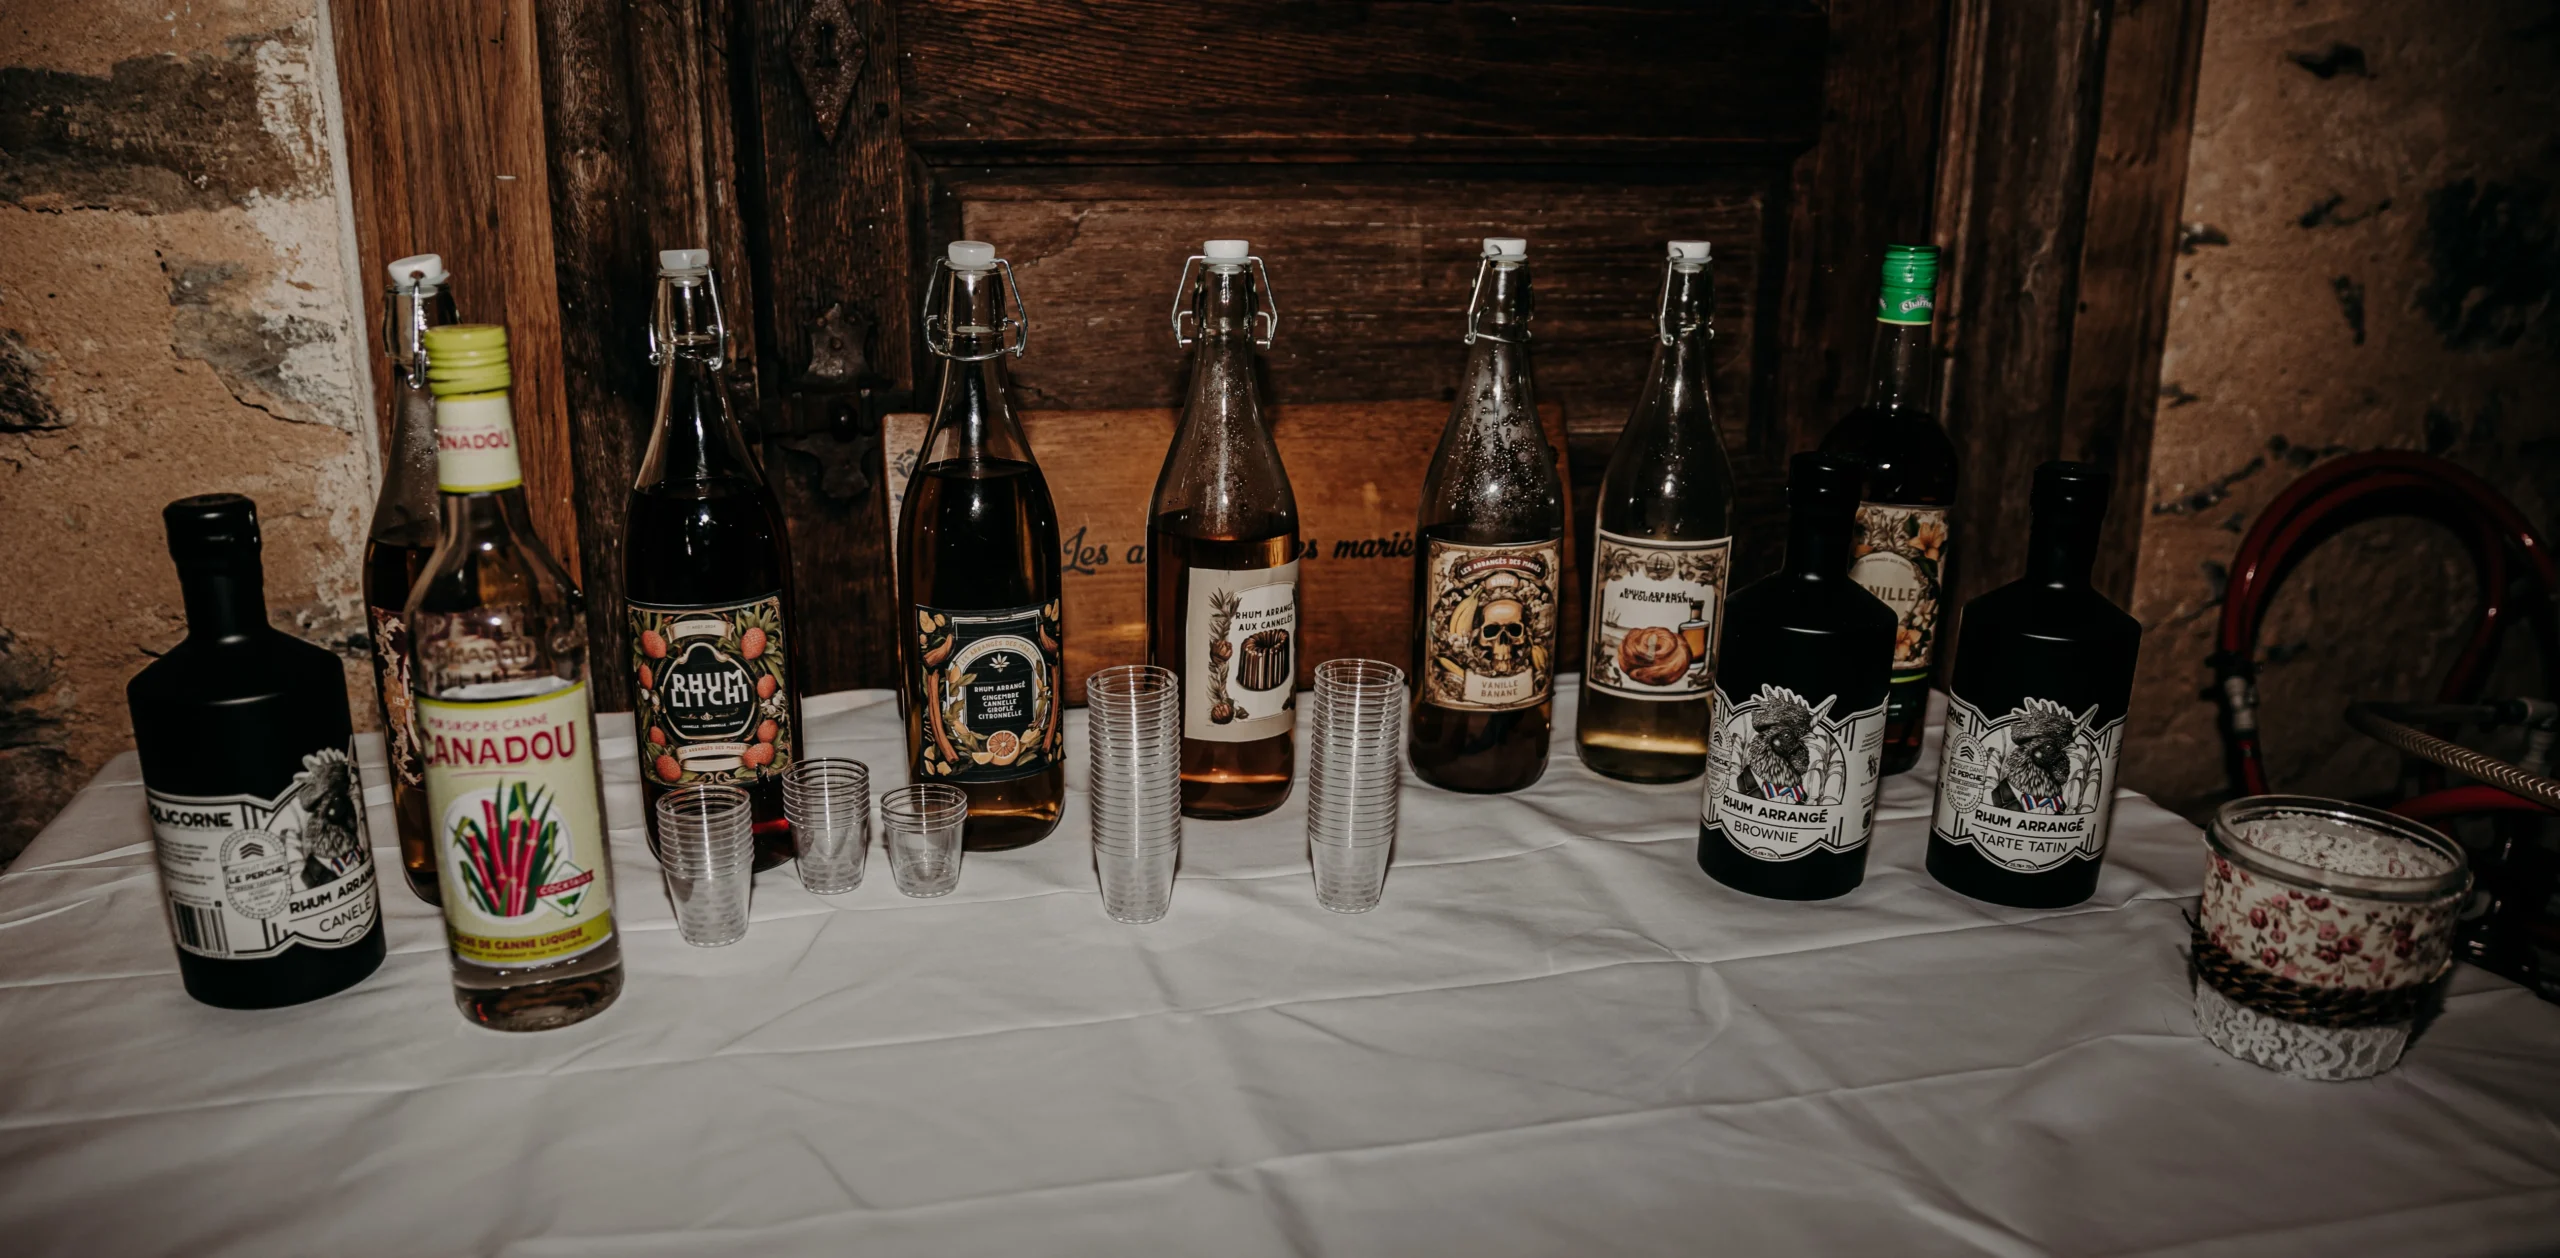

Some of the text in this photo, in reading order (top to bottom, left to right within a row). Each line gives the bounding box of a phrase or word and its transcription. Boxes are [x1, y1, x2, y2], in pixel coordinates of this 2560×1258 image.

[438, 429, 511, 450] ANADOU
[1062, 526, 1110, 576] Les
[1299, 538, 1318, 559] es
[1333, 530, 1415, 560] marié
[1460, 566, 1472, 575] LES
[1473, 557, 1507, 570] ARRANGÉS
[1490, 577, 1514, 587] RHUM
[1861, 584, 1916, 602] NILLE
[1235, 600, 1294, 620] RHUM ARRANGÉ
[1238, 612, 1293, 632] AUX CANNELÉS
[672, 669, 744, 693] RHUM
[974, 680, 1026, 693] RHUM ARRANGÉ
[1481, 679, 1518, 688] VANILLE
[671, 684, 749, 708] LITCHI
[982, 692, 1020, 701] GINGEMBRE
[983, 698, 1017, 707] CANNELLE
[1480, 688, 1518, 697] BANANE
[978, 710, 1022, 720] CITRONNELLE
[987, 705, 1014, 713] GIROFLE
[483, 720, 498, 732] DE
[502, 713, 549, 731] CANNE
[420, 720, 576, 766] CANADOU
[1958, 769, 1983, 782] PERCHE
[1722, 794, 1829, 823] RHUM ARRANGÉ
[1974, 809, 2085, 833] RHUM ARRANGÉ
[1733, 820, 1799, 844] BROWNIE
[1979, 831, 2068, 854] TARTE TATIN
[228, 875, 242, 885] LE
[245, 865, 285, 881] PERCHE
[289, 892, 332, 914] RHUM
[319, 893, 372, 932] CANELÉ
[494, 938, 537, 951] CANNE
[540, 927, 583, 947] LIQUIDE
